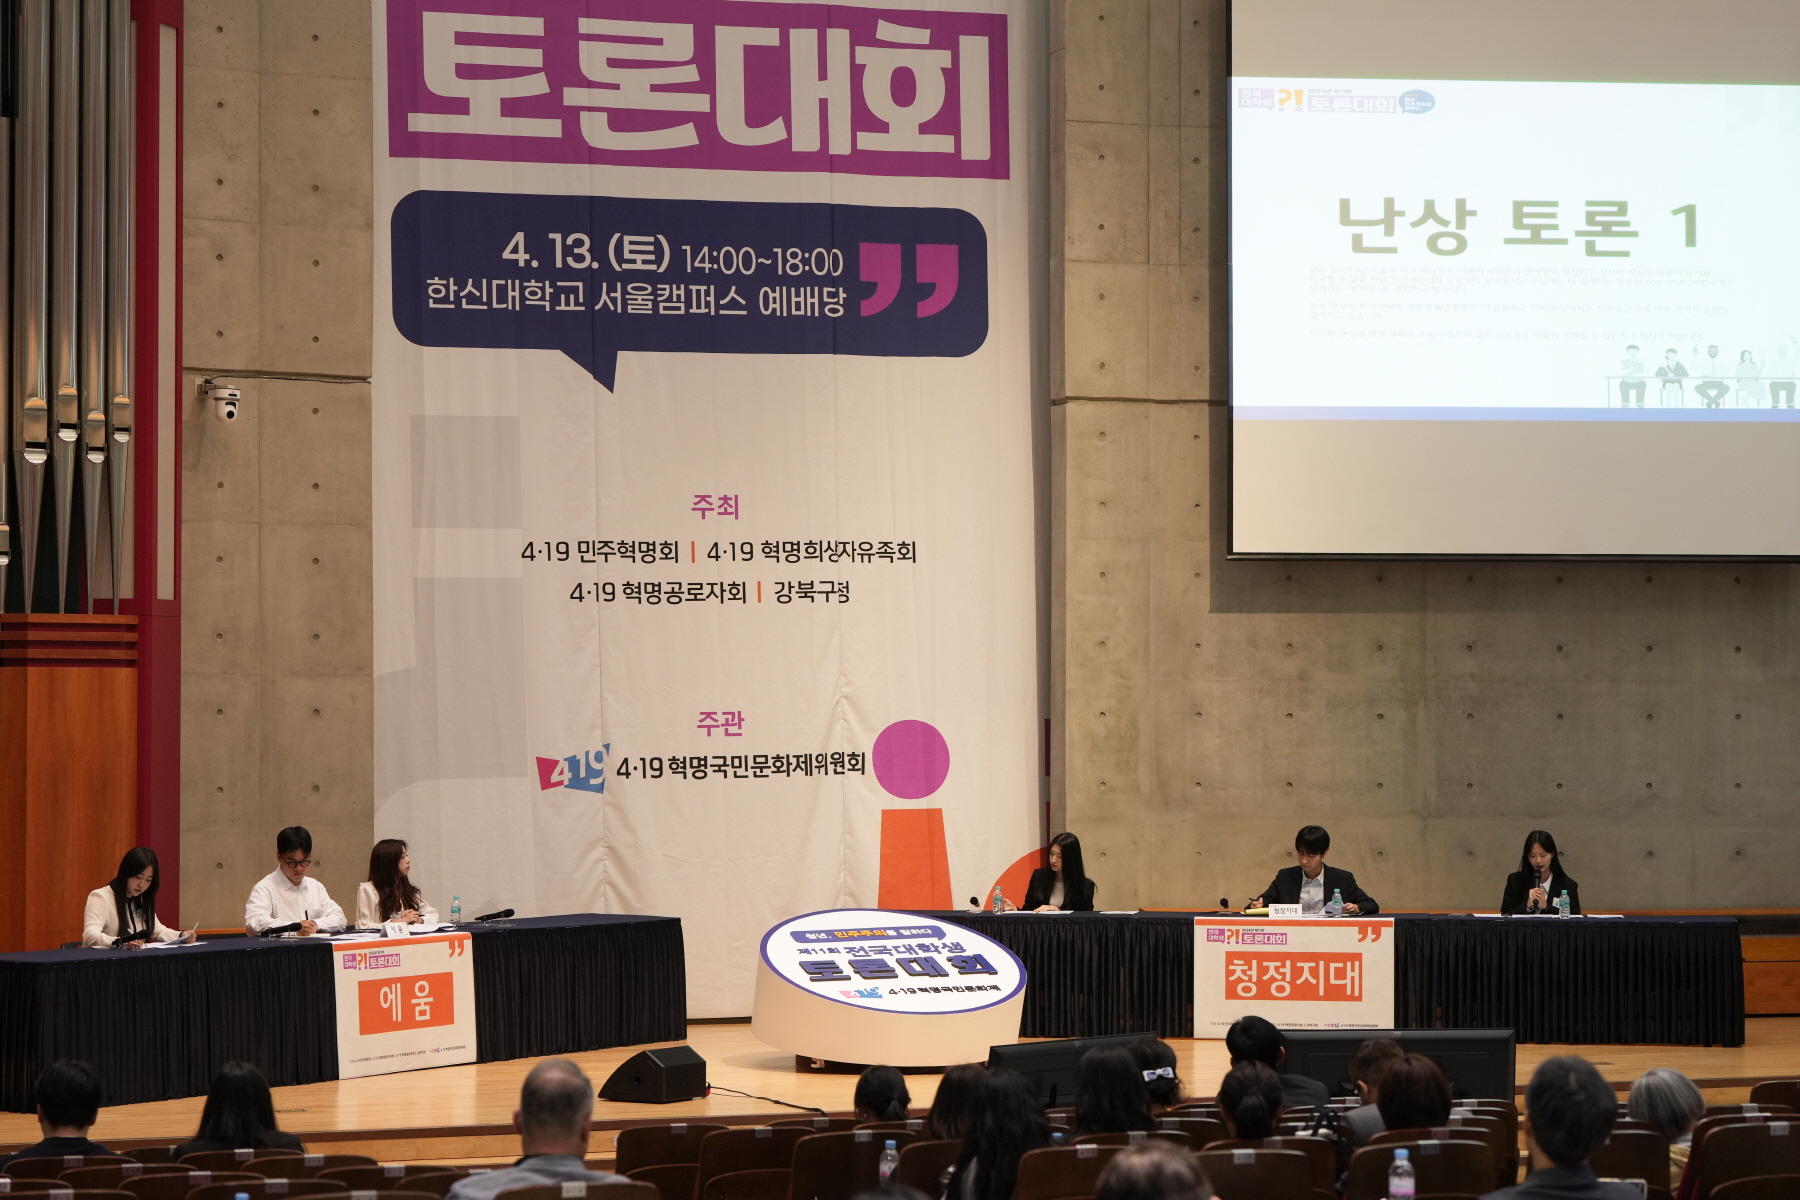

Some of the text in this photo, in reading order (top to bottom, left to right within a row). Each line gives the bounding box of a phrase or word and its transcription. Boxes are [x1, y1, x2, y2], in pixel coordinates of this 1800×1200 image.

[408, 11, 992, 161] 토론대회
[1310, 96, 1395, 113] 토론대회
[1338, 196, 1698, 258] 난상 토론 1
[502, 232, 844, 277] 4. 13. (토) 14:00~18:00
[426, 276, 848, 319] 한신대학교 서울캠퍼스 예배당
[691, 495, 740, 520] 주최
[521, 540, 680, 564] 4·19 민주혁명회
[707, 540, 754, 563] 4·19
[622, 580, 748, 605] 혁명공로자회
[696, 711, 745, 737] 주관
[1274, 907, 1298, 915] 청정지대
[833, 928, 898, 939] 민주주의를
[1242, 933, 1287, 945] 토론대회
[369, 954, 400, 968] 토론대회
[843, 941, 967, 958] 전국대학생
[799, 953, 999, 982] 토론대회
[1228, 959, 1360, 998] 청정지대
